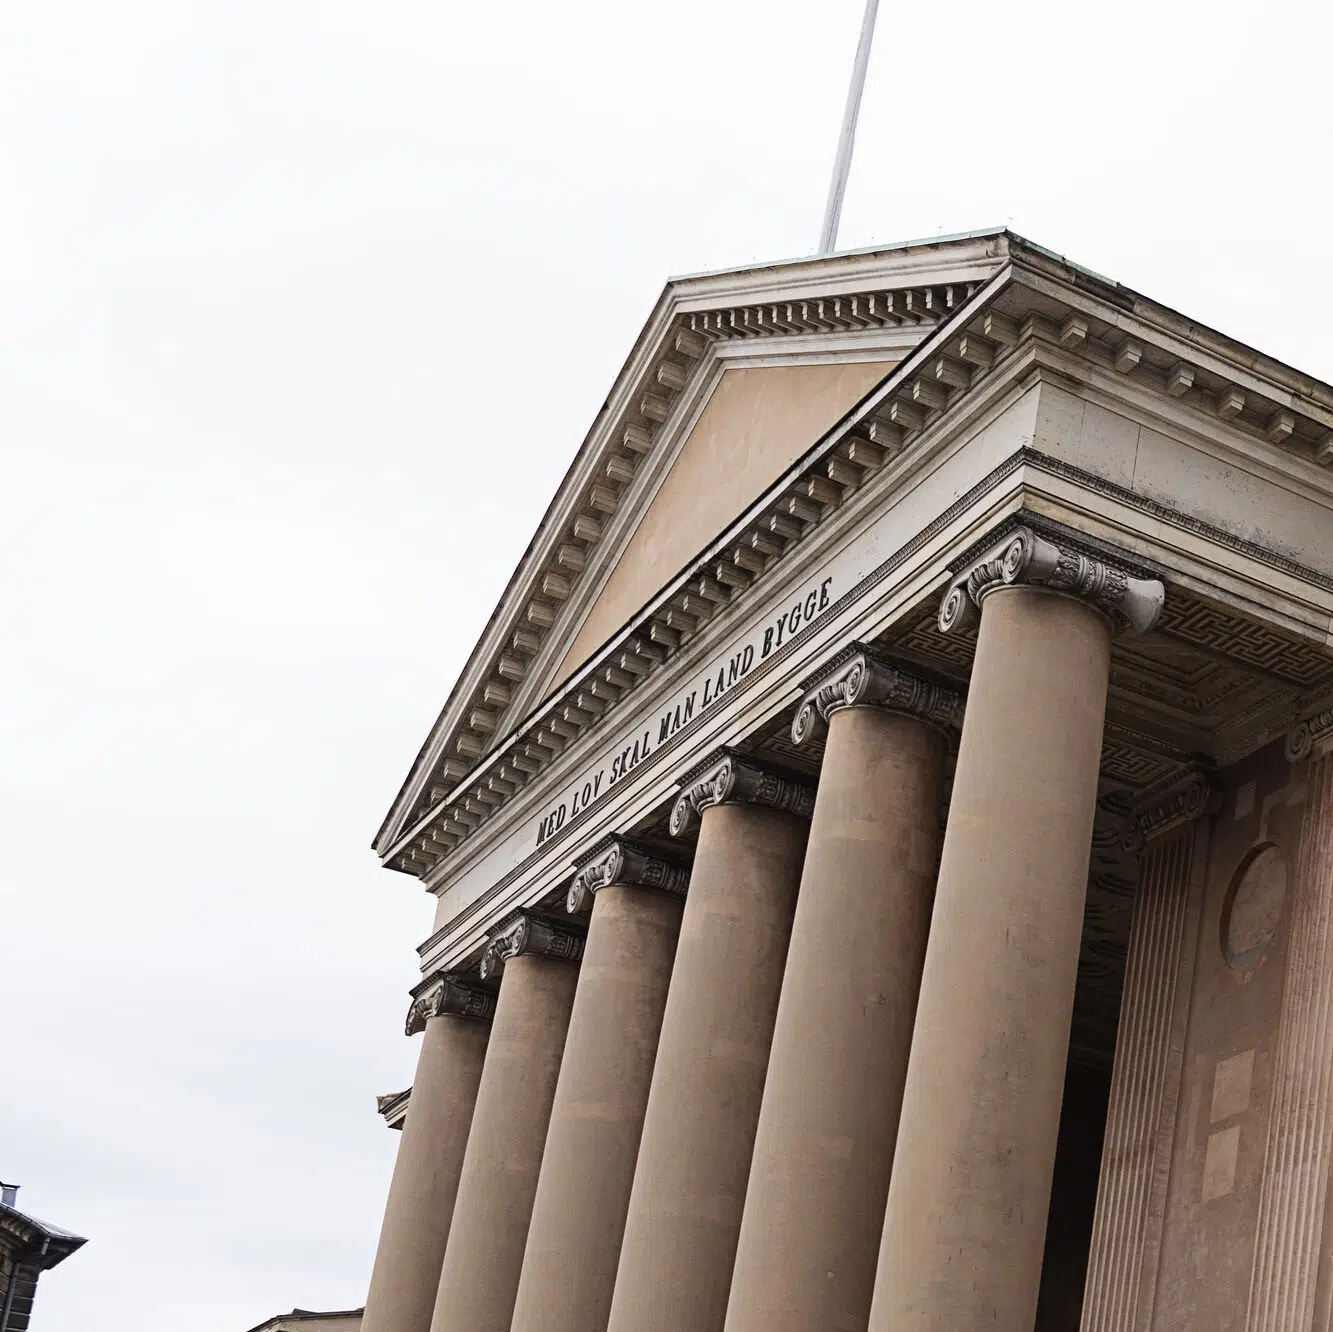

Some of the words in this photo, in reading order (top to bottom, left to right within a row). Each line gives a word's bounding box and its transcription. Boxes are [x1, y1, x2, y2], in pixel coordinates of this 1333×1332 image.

[536, 803, 567, 847] MED
[570, 769, 605, 819] LOV
[609, 731, 652, 785] SKAL
[657, 690, 698, 745] MAN
[702, 644, 755, 707] LAND
[761, 577, 832, 658] BYGGE
